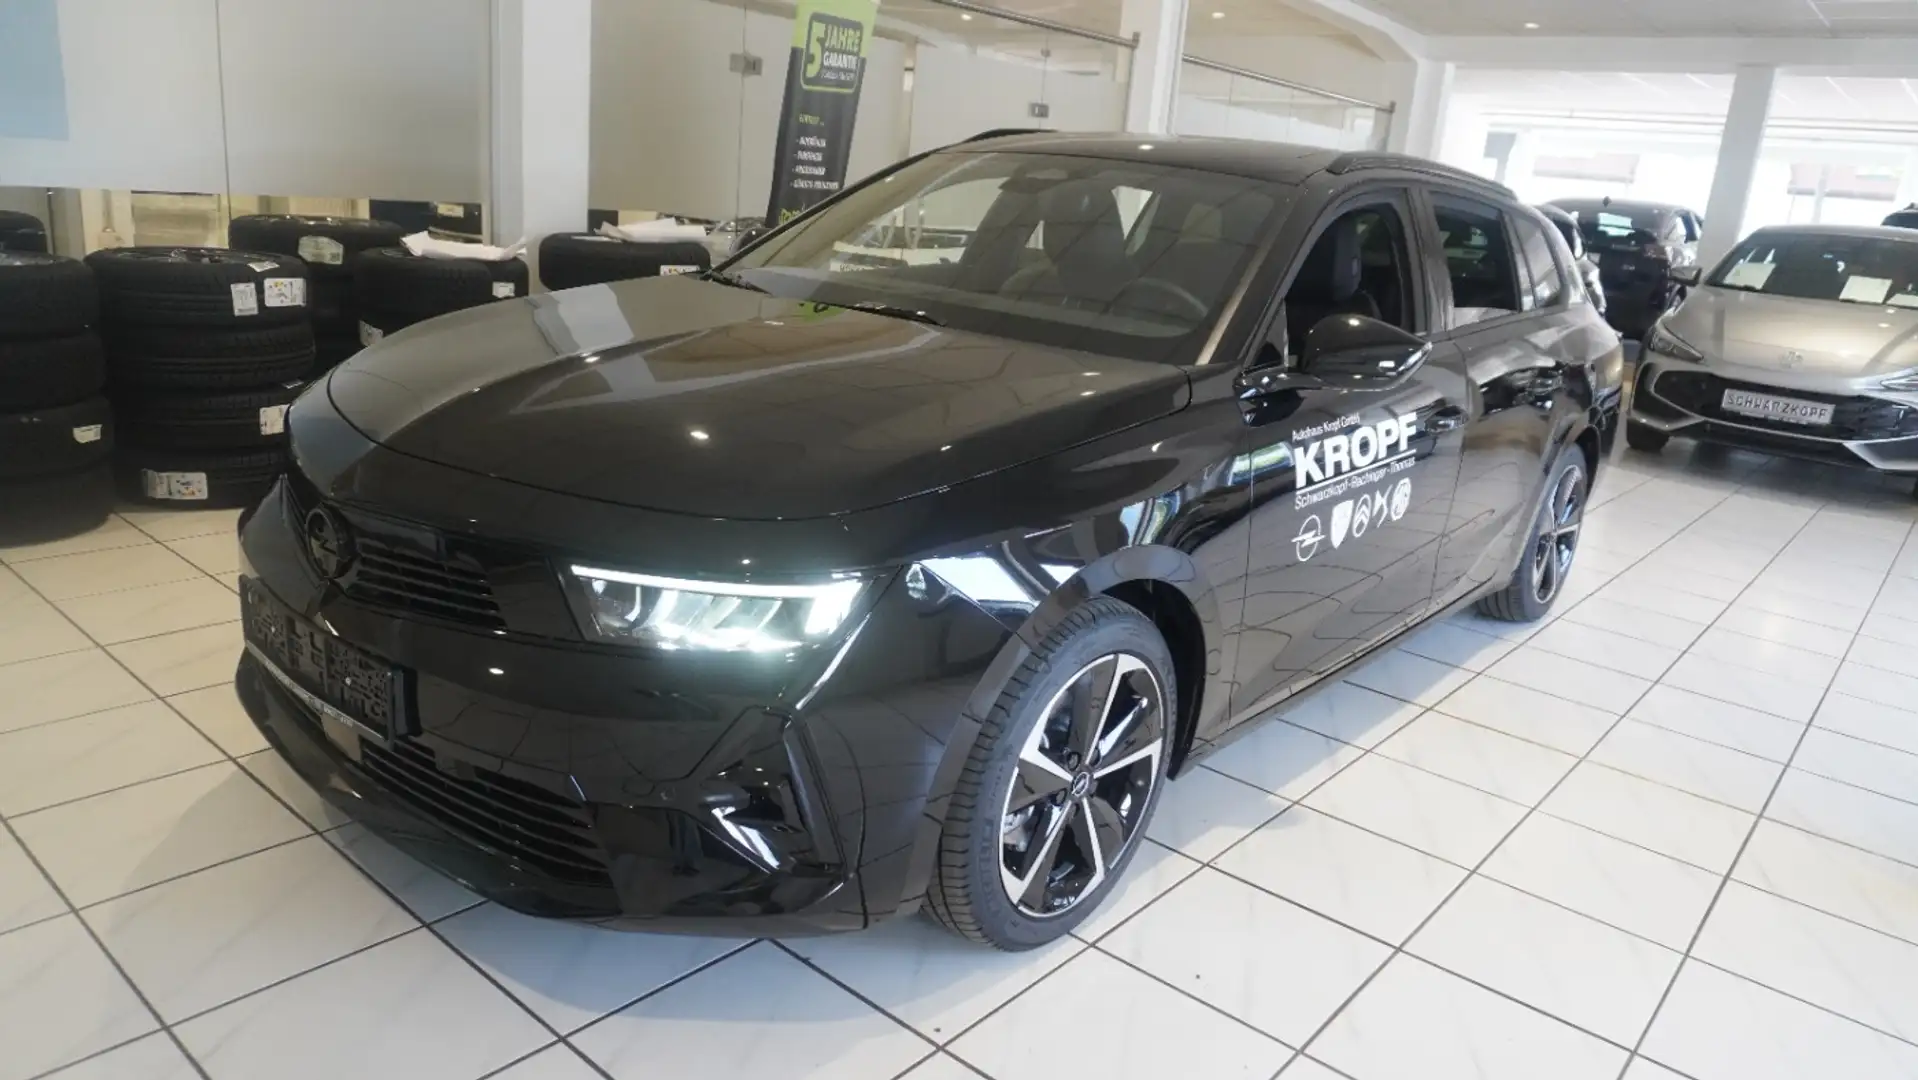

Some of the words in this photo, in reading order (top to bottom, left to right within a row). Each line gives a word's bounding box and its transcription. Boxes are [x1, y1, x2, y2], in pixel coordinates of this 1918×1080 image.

[806, 20, 826, 78] 5
[825, 24, 861, 52] JAHRE
[1726, 393, 1829, 419] SCHWARZKOPF
[1294, 412, 1418, 489] KROPF
